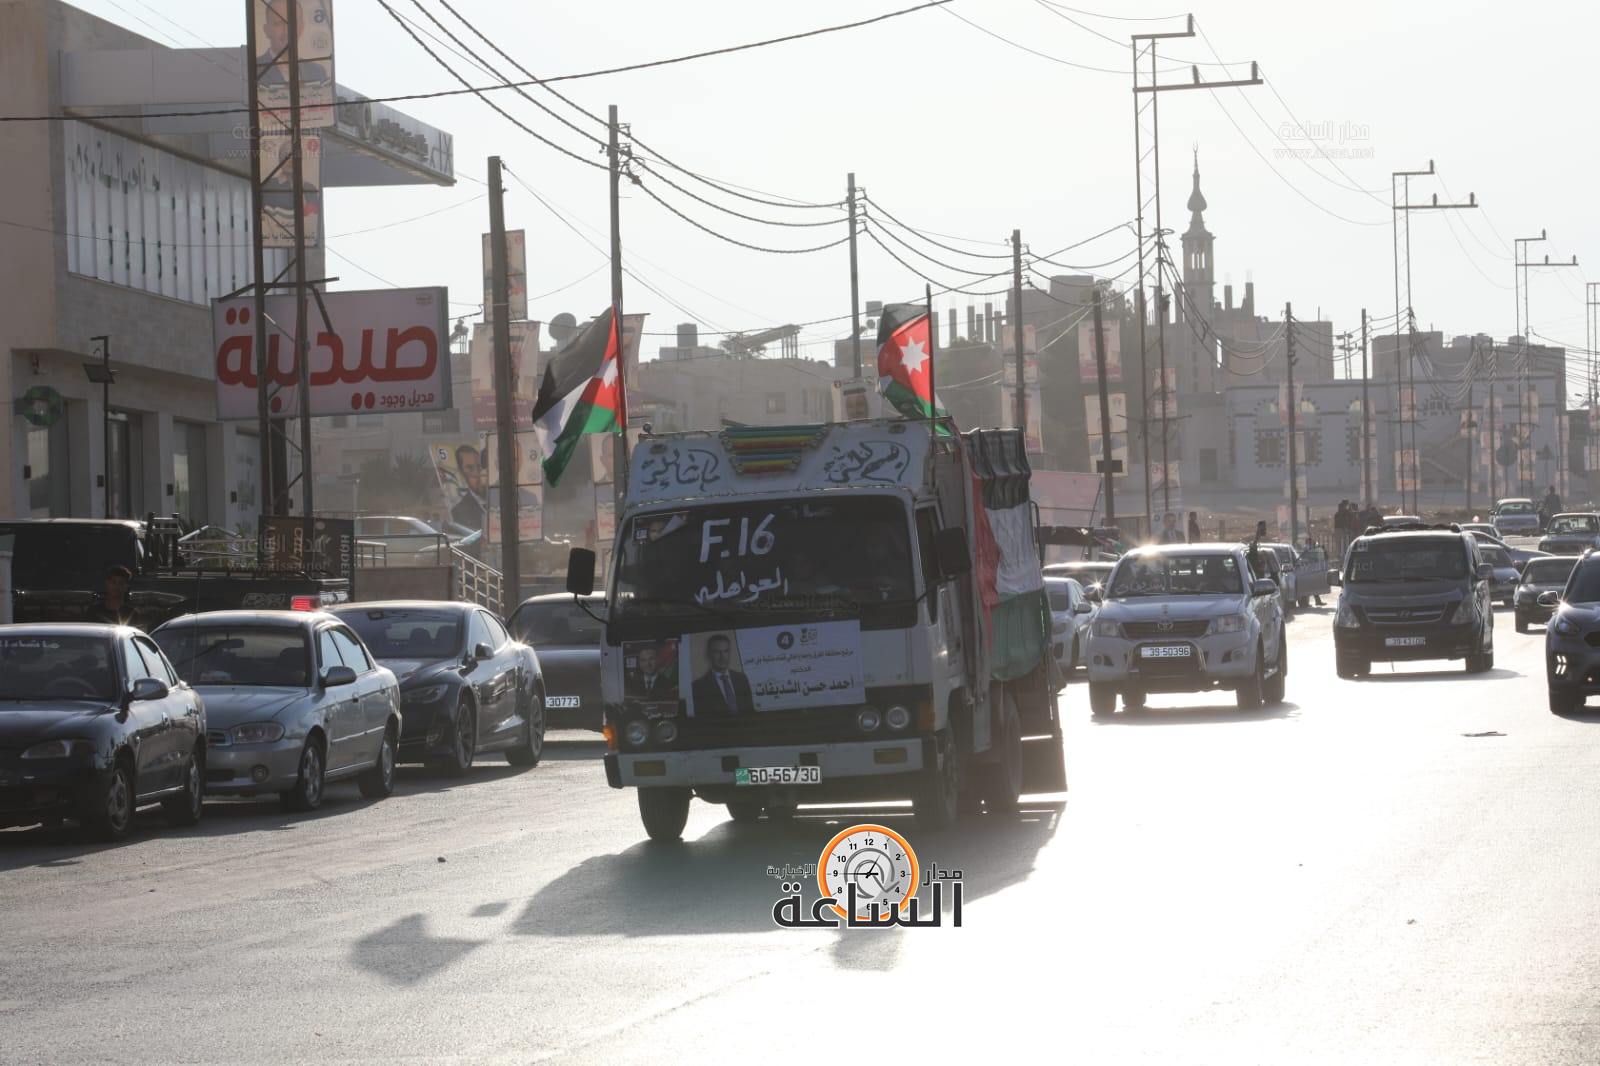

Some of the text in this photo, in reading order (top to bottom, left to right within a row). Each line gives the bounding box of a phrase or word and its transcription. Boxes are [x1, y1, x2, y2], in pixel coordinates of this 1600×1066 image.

[408, 389, 434, 407] هديل
[699, 513, 776, 563] F.16
[339, 534, 351, 578] HADEE
[830, 674, 855, 690] أحمد
[750, 768, 819, 783] 60-56730
